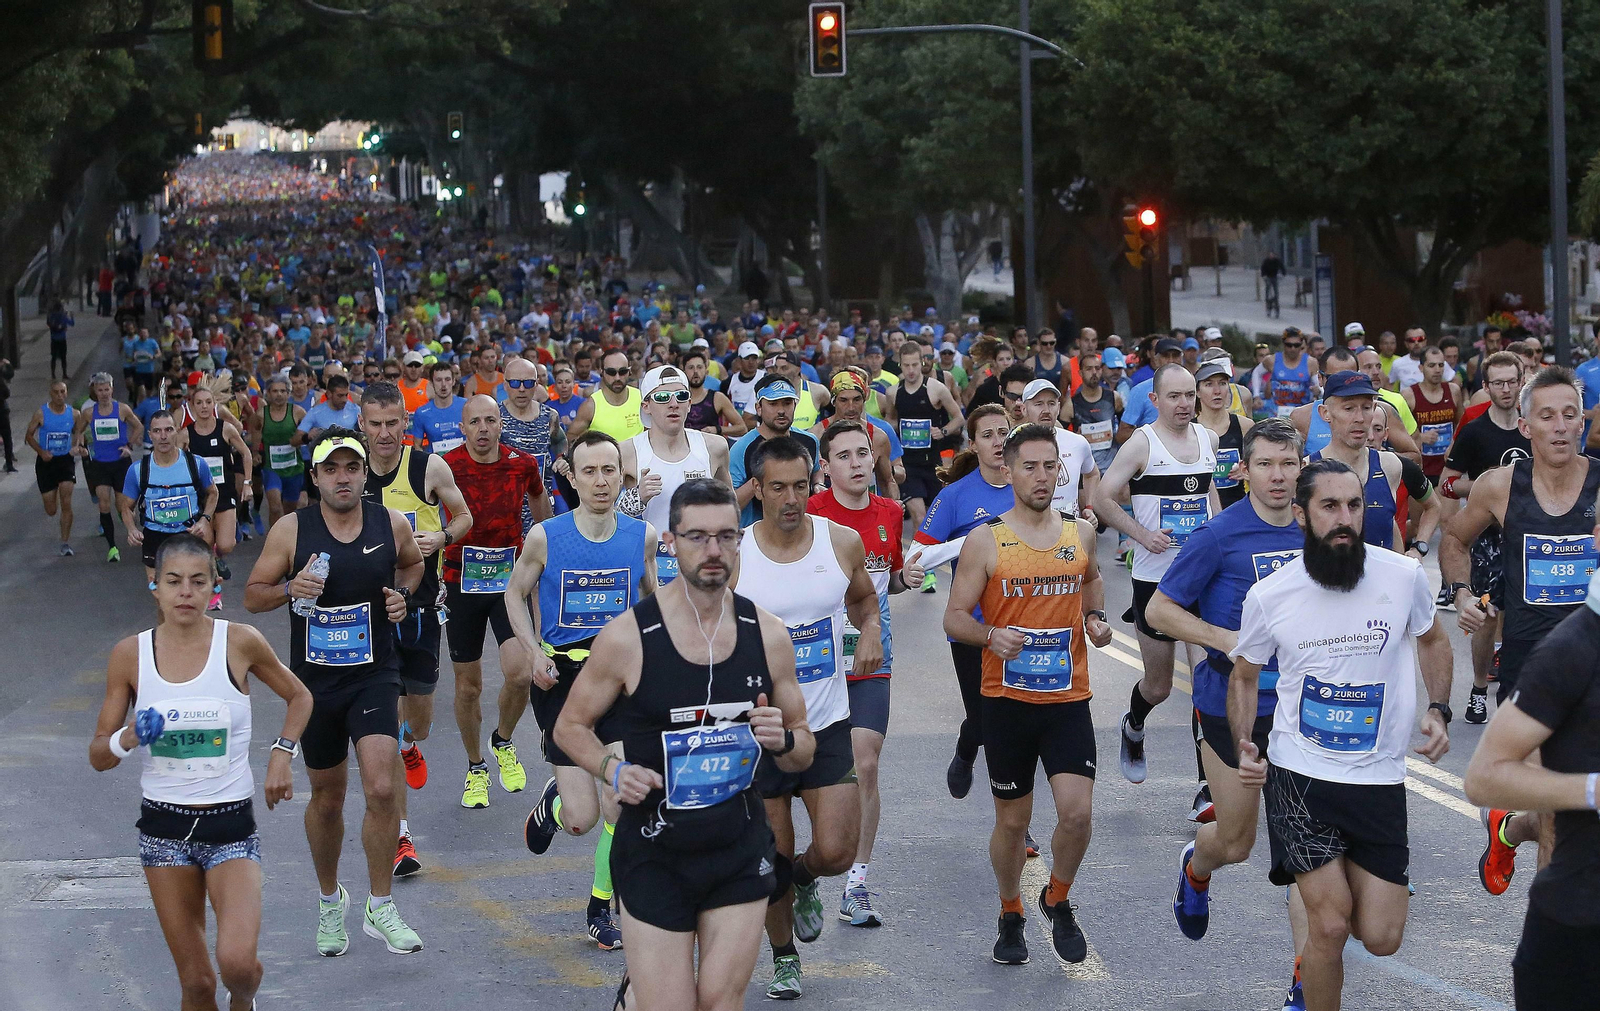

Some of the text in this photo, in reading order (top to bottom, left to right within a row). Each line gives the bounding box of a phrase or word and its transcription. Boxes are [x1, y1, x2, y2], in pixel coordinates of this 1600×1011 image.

[165, 510, 178, 519] 949
[923, 498, 942, 531] RCM1873
[1179, 517, 1196, 527] 412
[1554, 544, 1585, 553] ZURICH
[480, 565, 498, 574] 574
[1550, 564, 1575, 576] 438
[589, 577, 616, 585] ZURICH
[1010, 573, 1077, 587] Club Deportivo
[1001, 578, 1024, 598] LA
[585, 593, 607, 604] 379
[330, 613, 357, 622] ZURICH
[327, 630, 349, 642] 360
[791, 627, 819, 639] ZURICH
[1034, 637, 1061, 645] ZURICH
[796, 646, 812, 659] 47
[1028, 654, 1051, 667] 225
[1333, 690, 1367, 699] ZURICH
[183, 710, 219, 719] ZURICH
[1326, 709, 1354, 723] 302
[170, 732, 206, 747] 5134
[704, 733, 739, 744] ZURICH
[700, 756, 731, 773] 472
